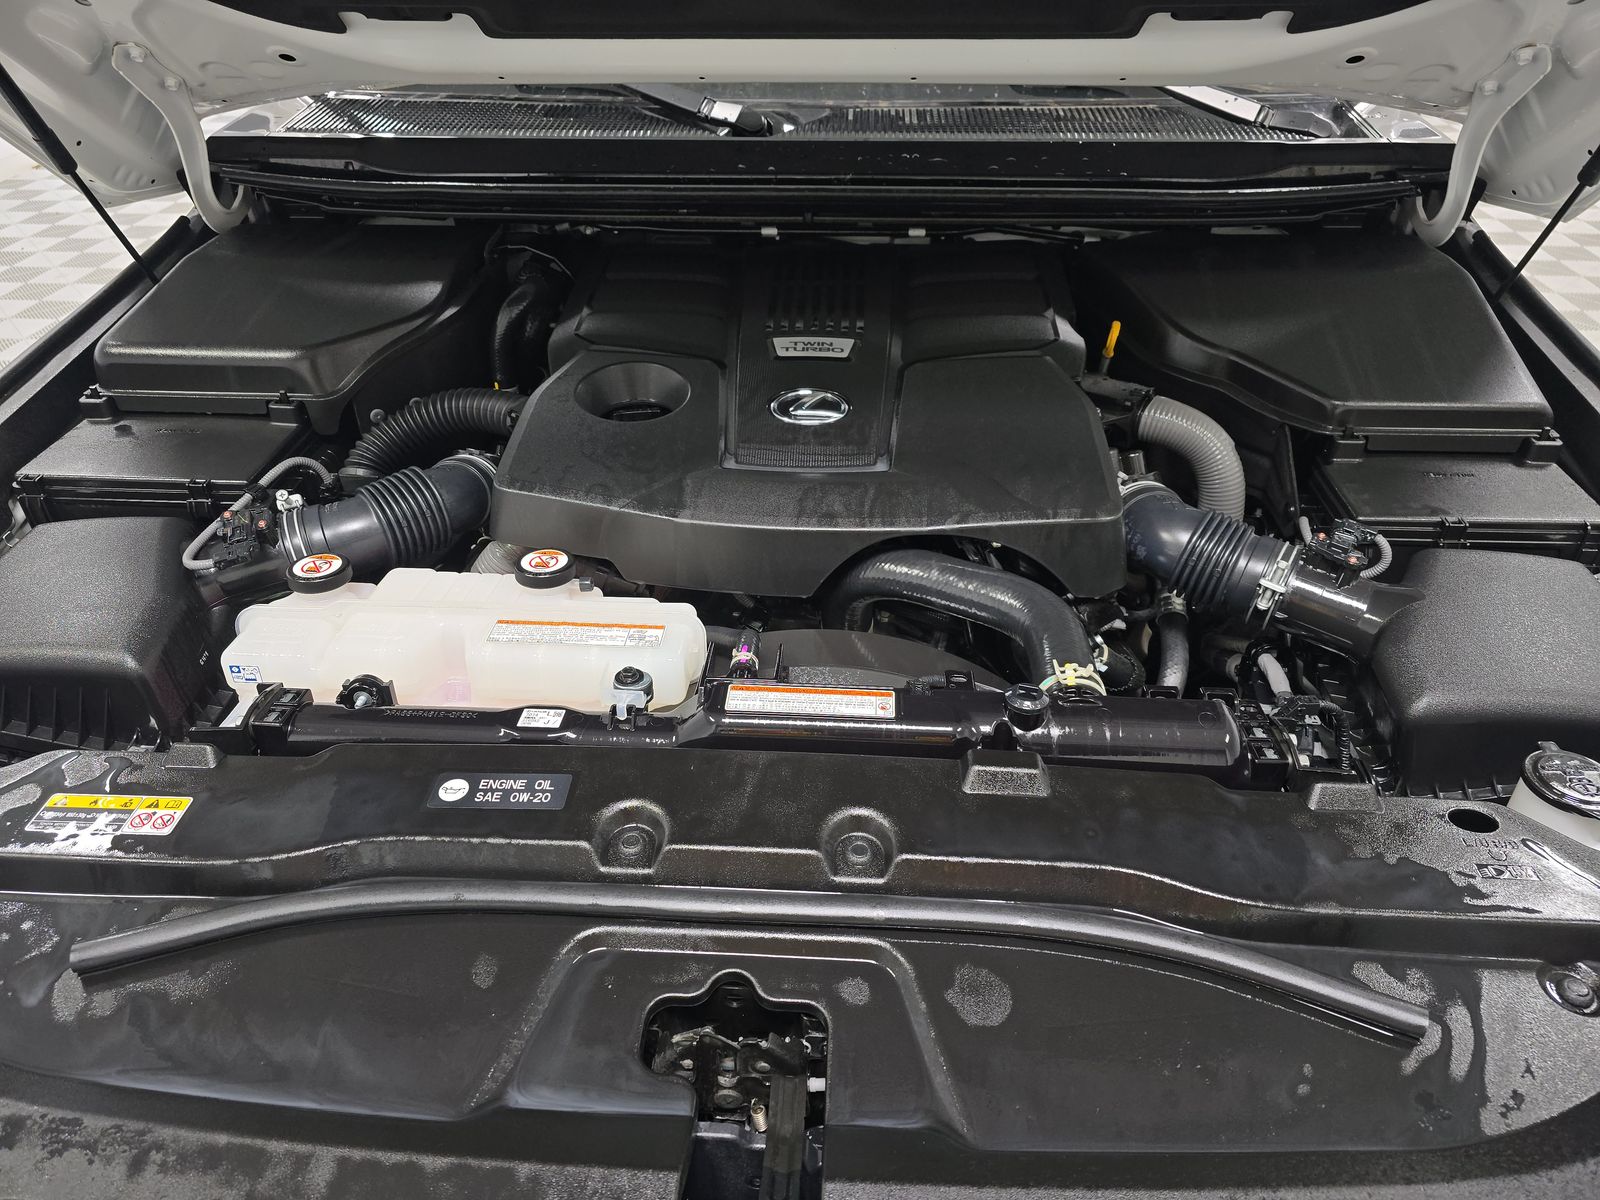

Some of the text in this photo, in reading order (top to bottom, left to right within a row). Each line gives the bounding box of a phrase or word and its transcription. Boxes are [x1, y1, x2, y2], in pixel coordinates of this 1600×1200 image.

[478, 779, 555, 790] ENGINE OIL
[474, 792, 551, 803] SAE 0W-20
